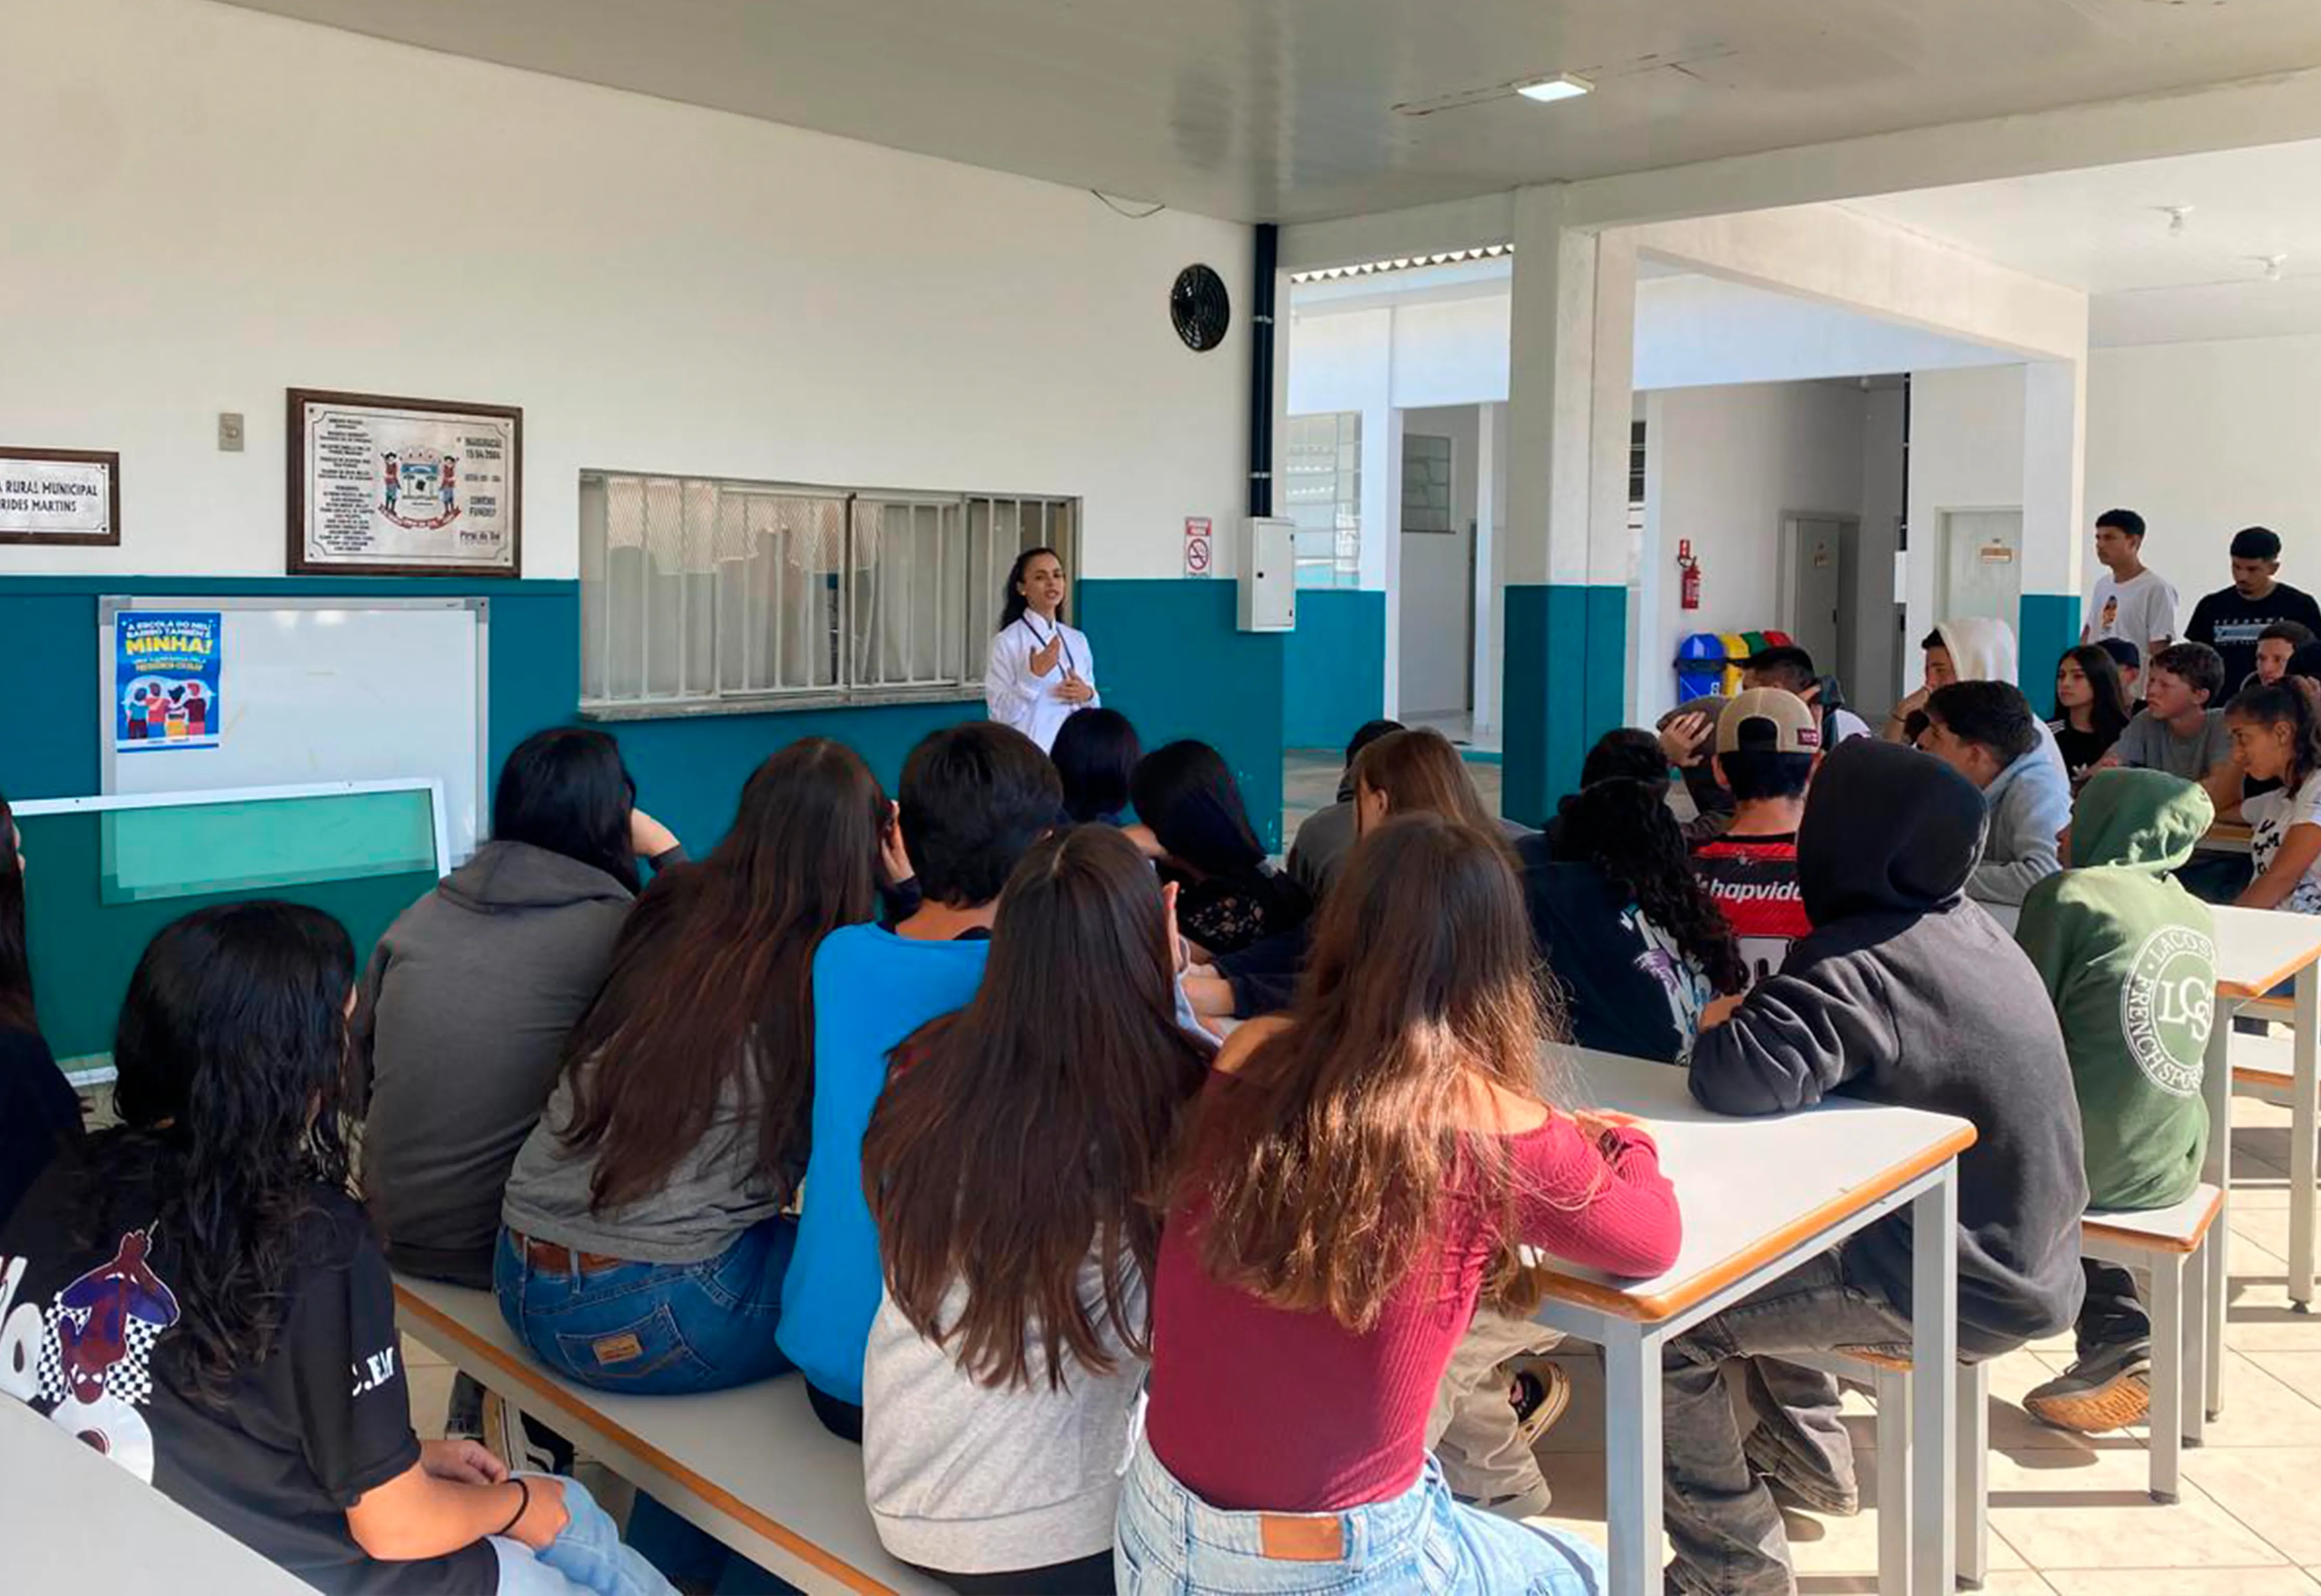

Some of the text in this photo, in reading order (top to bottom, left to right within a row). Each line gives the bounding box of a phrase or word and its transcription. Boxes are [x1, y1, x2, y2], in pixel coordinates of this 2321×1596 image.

[6, 480, 38, 494] RURAL
[43, 482, 98, 496] MUNICIPAL
[32, 500, 77, 512] MARTINS
[126, 636, 214, 655] MINHA!
[2149, 933, 2210, 962] LACOS
